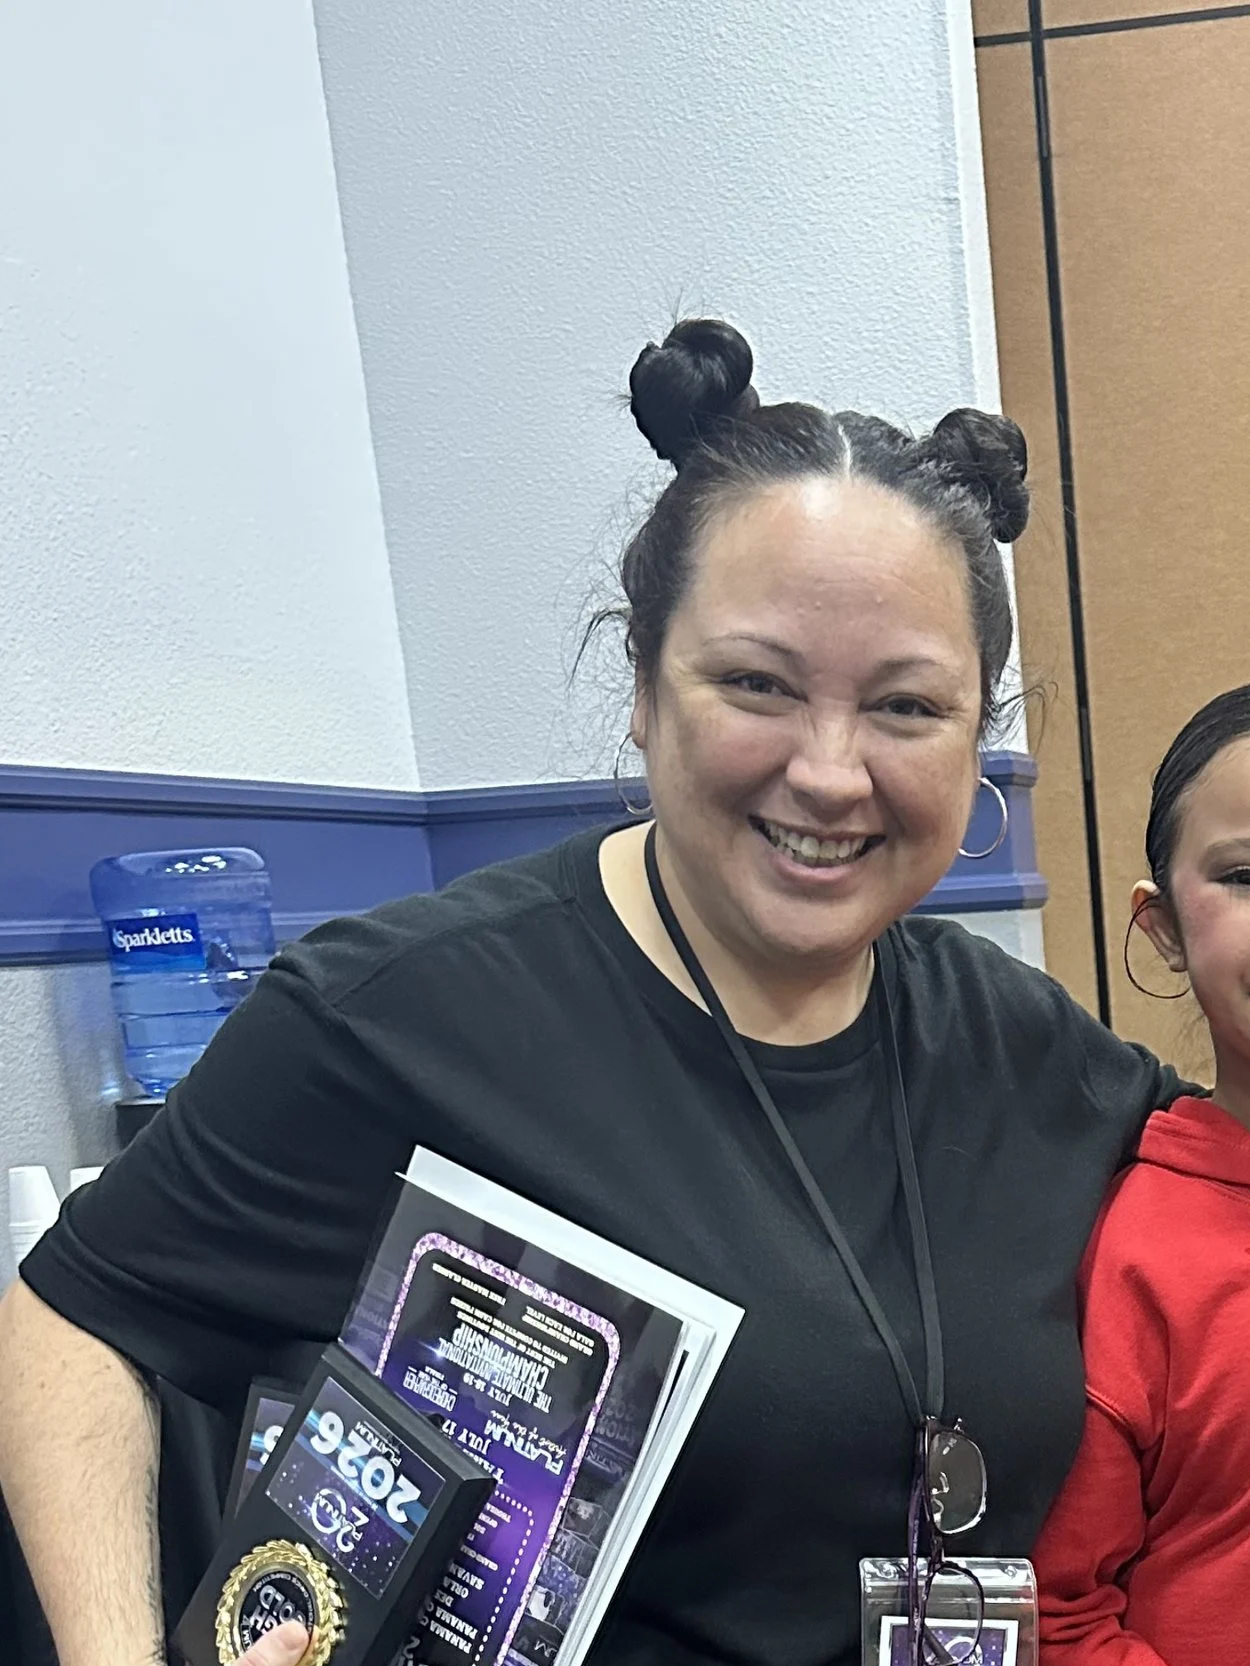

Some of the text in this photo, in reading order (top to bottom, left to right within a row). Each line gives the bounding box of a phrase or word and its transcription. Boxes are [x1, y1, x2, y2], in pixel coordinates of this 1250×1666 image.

[113, 927, 194, 953] Sparkletts
[449, 1321, 549, 1391] CHAMPIONSHIP
[486, 1385, 512, 1406] JULY
[490, 1368, 535, 1403] ULTIMATE
[532, 1389, 552, 1413] THE
[354, 1420, 402, 1467] PLATINUM
[440, 1418, 492, 1455] JULY 17
[482, 1418, 564, 1475] PLATINUM
[308, 1411, 421, 1522] 2026
[311, 1488, 370, 1551] 20
[428, 1619, 472, 1654] PANAMA
[434, 1605, 478, 1640] PANAMA
